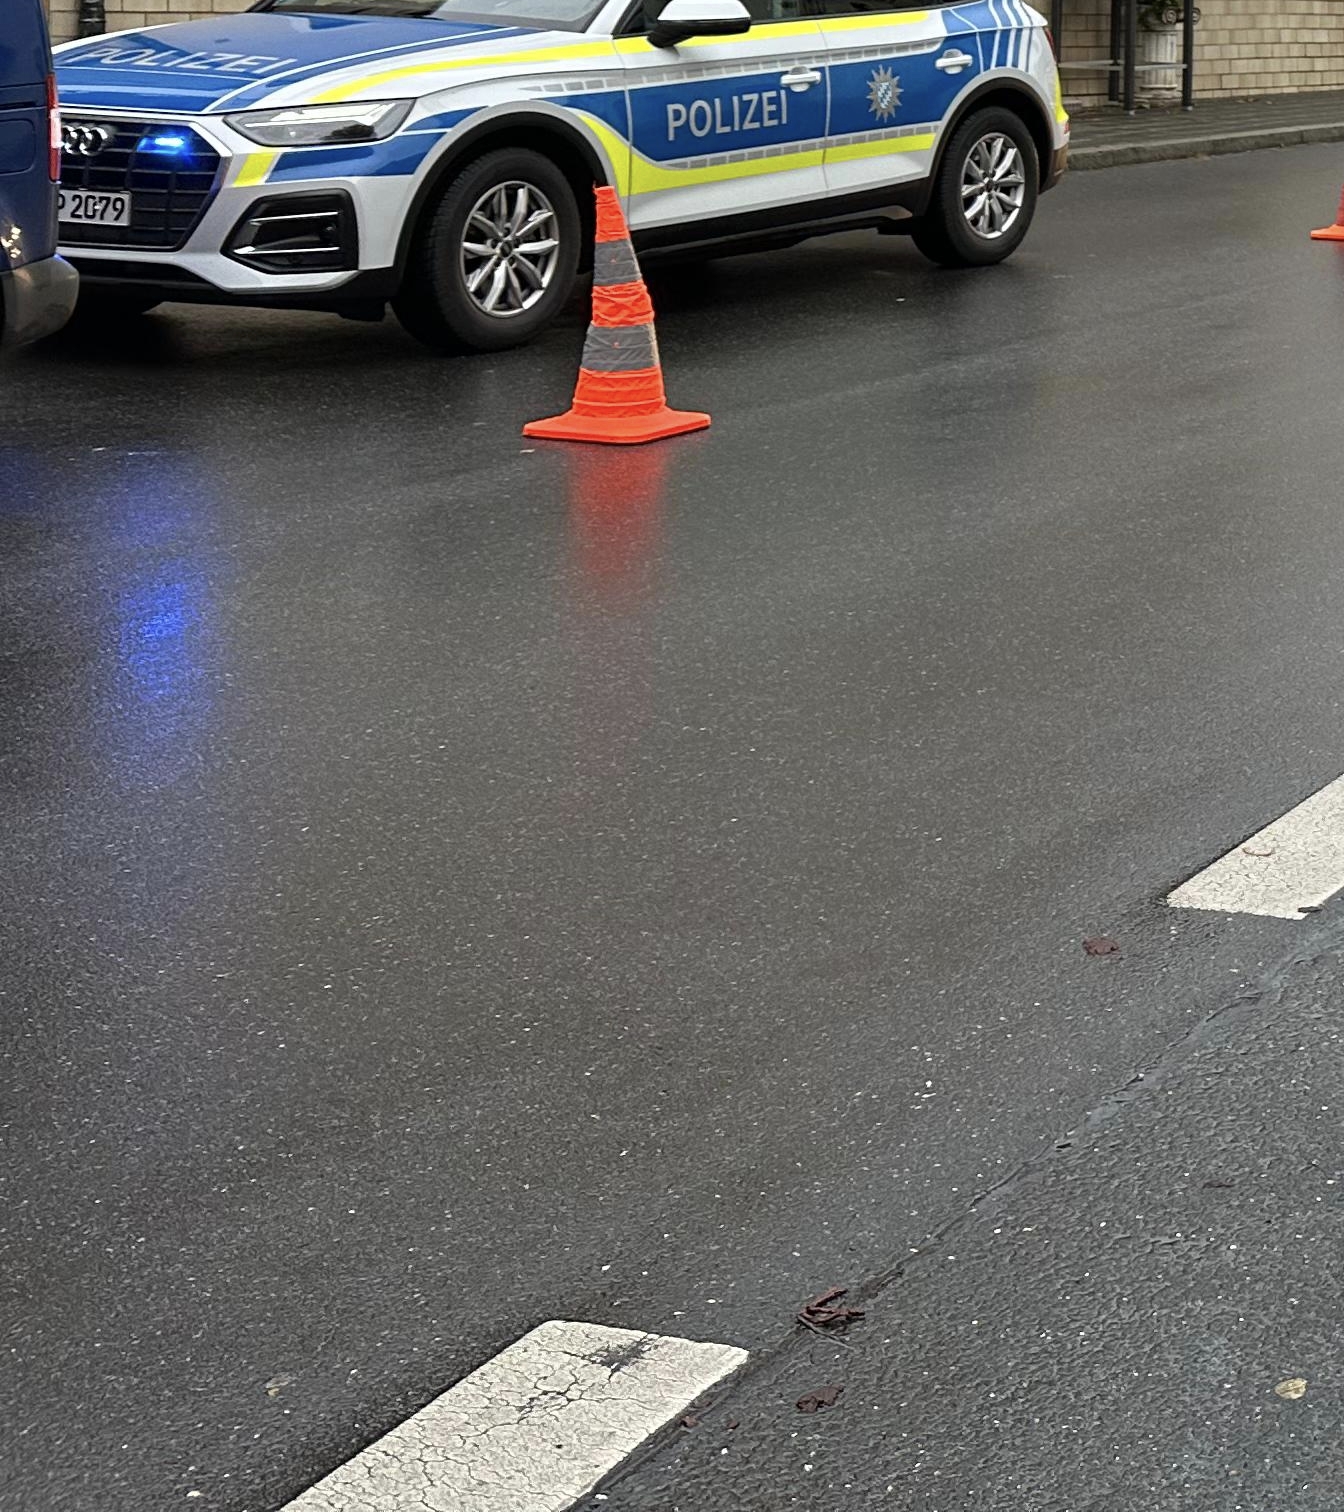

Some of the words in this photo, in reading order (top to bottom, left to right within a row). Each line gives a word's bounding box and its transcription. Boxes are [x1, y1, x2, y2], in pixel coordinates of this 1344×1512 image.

[66, 47, 298, 75] POLIZEI
[666, 89, 788, 142] POLIZEI
[70, 194, 126, 221] 2079
